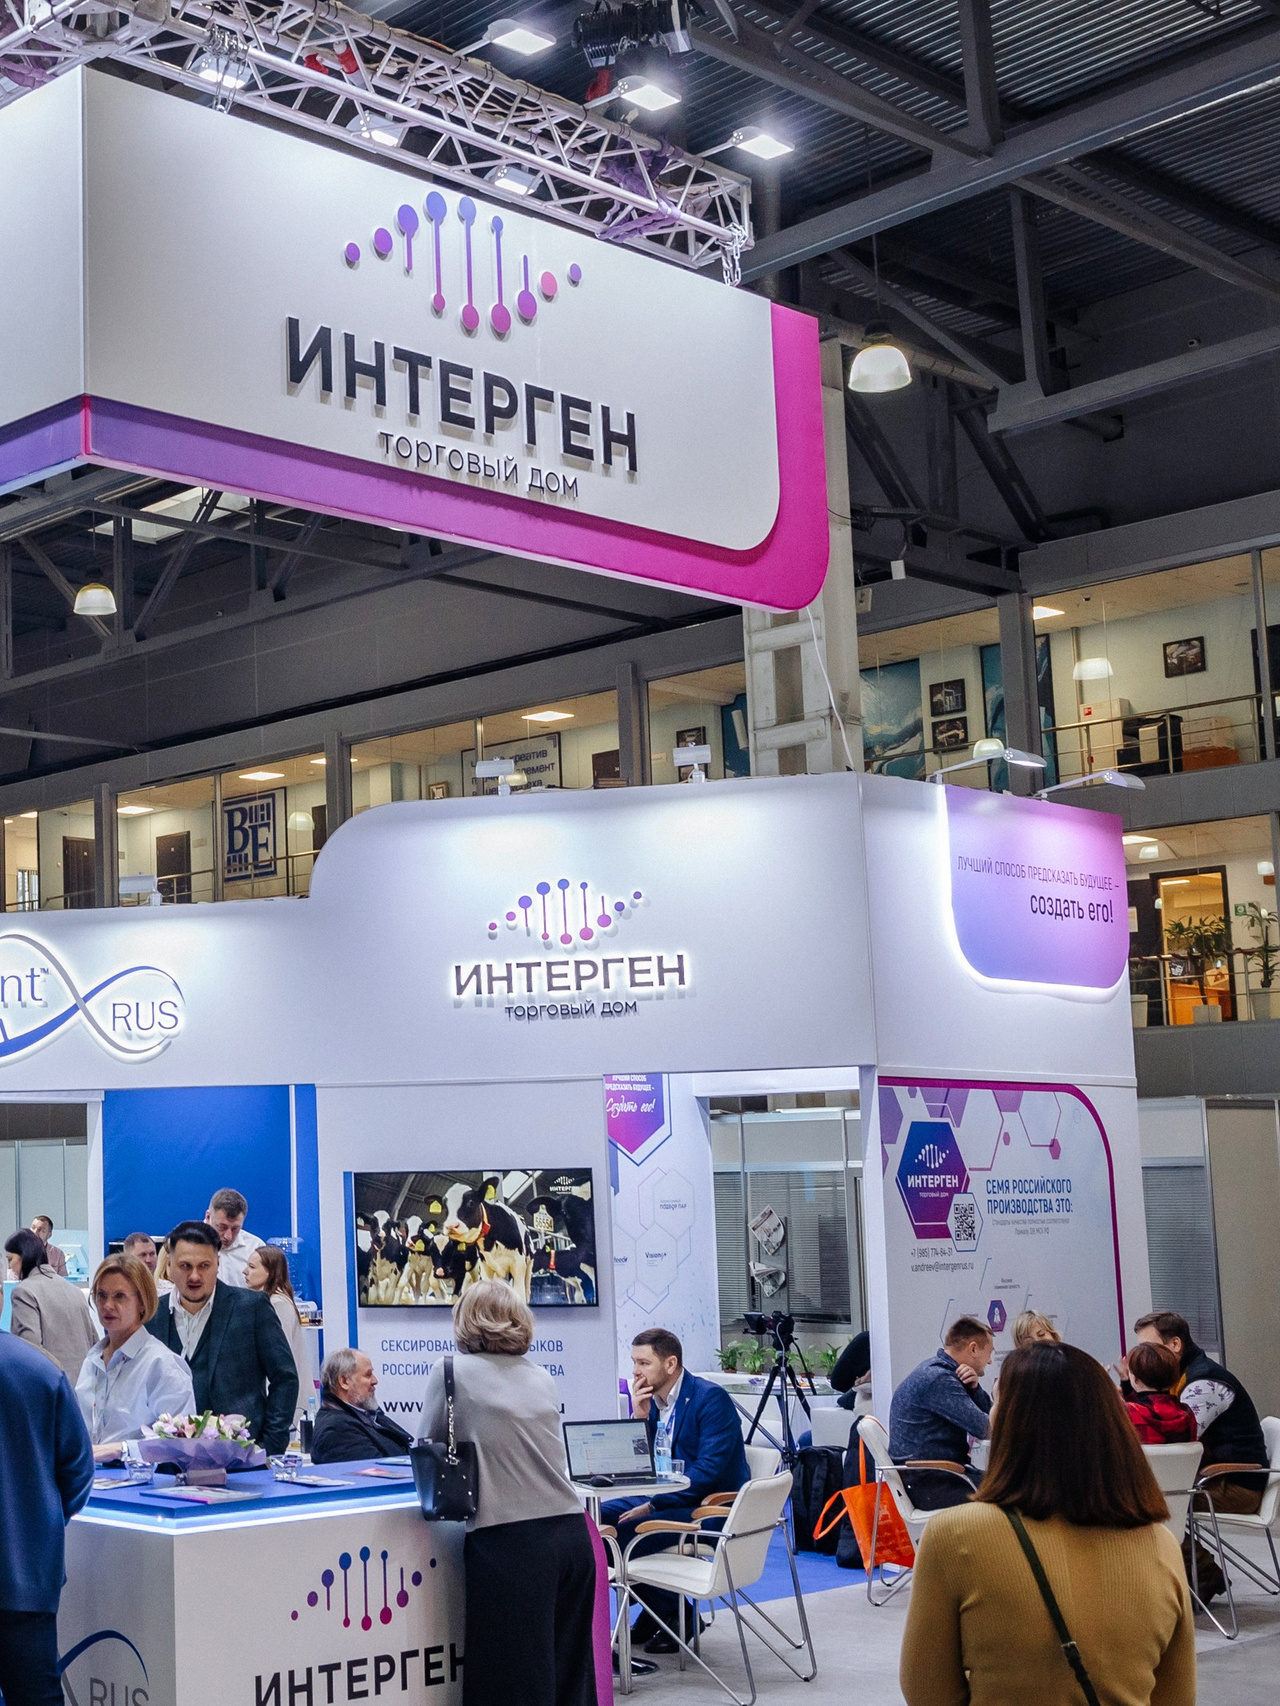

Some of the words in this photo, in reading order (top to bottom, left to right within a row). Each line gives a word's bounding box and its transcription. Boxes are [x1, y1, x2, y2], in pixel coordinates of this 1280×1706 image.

[286, 316, 638, 473] ИНТЕРГЕН
[379, 431, 518, 484] торговый
[528, 467, 579, 498] дом
[957, 855, 993, 875] ЛУЧШИЙ
[994, 860, 1026, 879] СПОСОБ
[1027, 865, 1078, 886] ПРЕДСКАЗАТЬ
[1079, 873, 1113, 891] БУДУЩЕЕ
[1030, 894, 1085, 921] создать
[1088, 899, 1114, 923] его!
[454, 953, 687, 996] ИНТЕРГЕН
[111, 1000, 180, 1032] RUS
[504, 999, 596, 1021] торговый
[600, 1000, 638, 1017] дом
[907, 1174, 959, 1188] ИНТЕРГЕН
[986, 1178, 1010, 1195] СЕМЯ
[1013, 1175, 1072, 1194] РОССИЙСКОГО
[987, 1199, 1053, 1215] ПРОИЗВОДСТВА
[1055, 1198, 1074, 1213] ЭТО:
[381, 1339, 455, 1352] СЕКСИРОВАН
[529, 1339, 564, 1352] ЫКОВ
[254, 1643, 465, 1706] ИНТЕРГЕН
